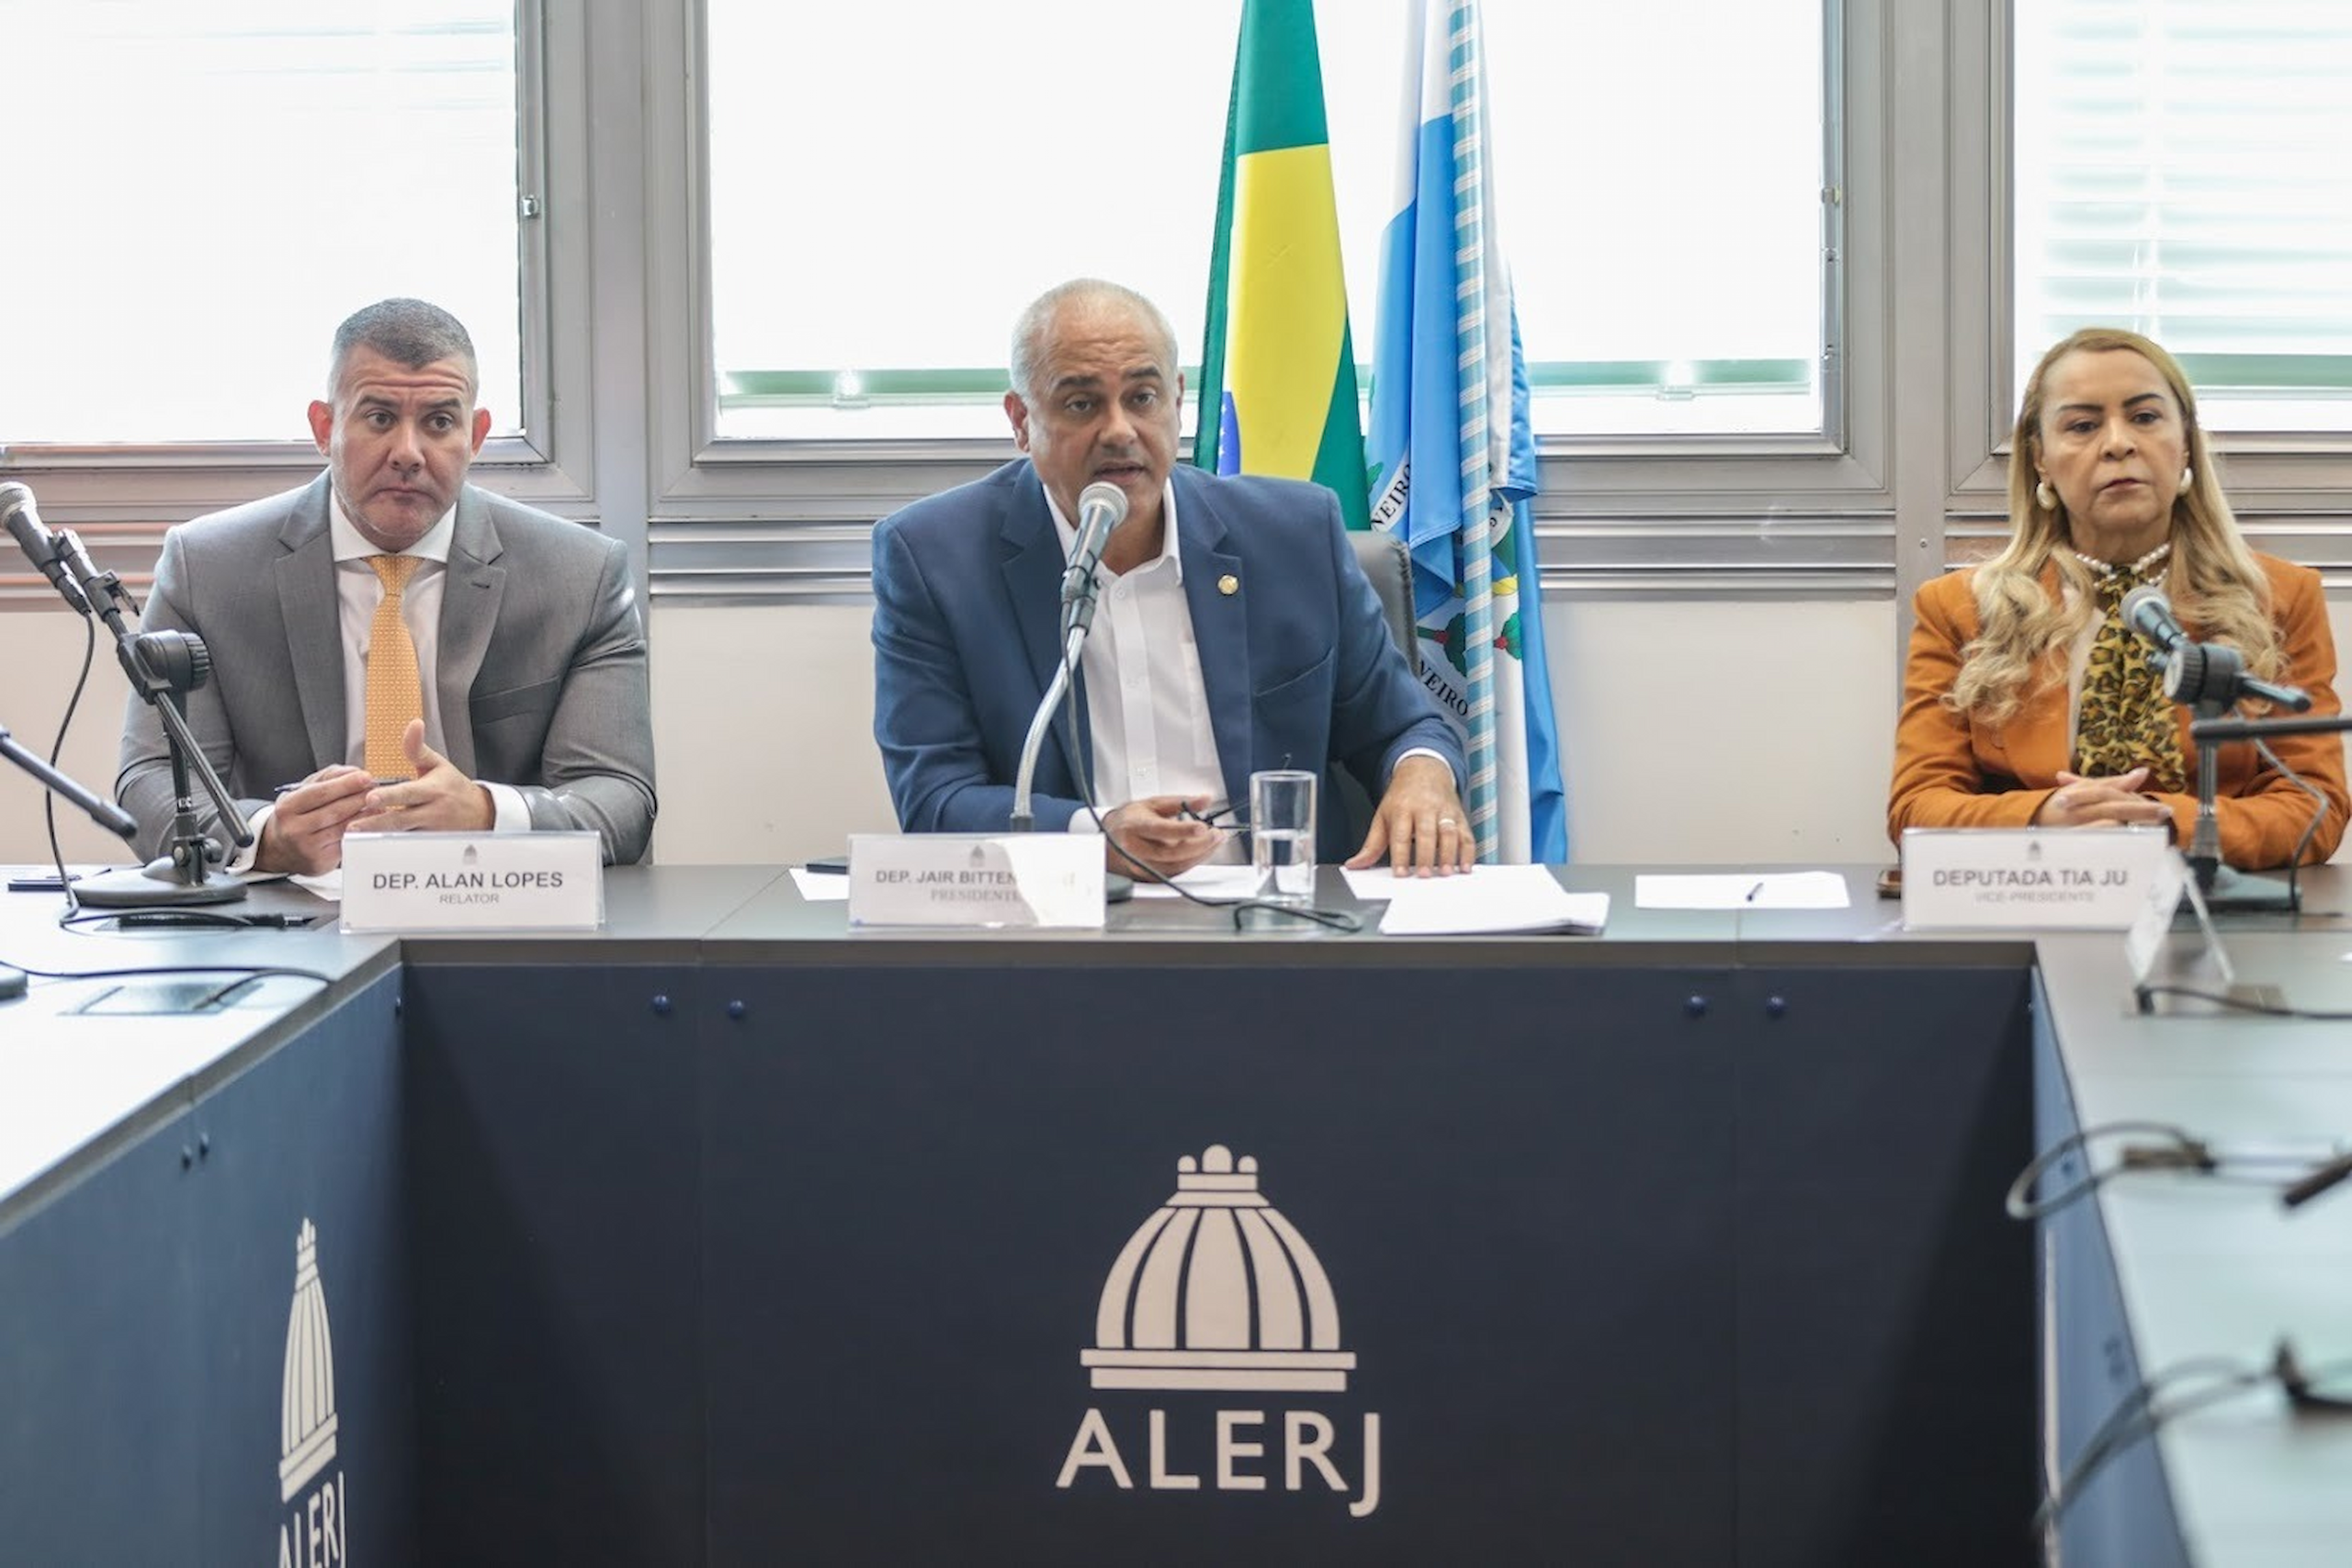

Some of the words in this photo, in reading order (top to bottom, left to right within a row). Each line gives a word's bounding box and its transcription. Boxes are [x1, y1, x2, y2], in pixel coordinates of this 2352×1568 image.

[372, 874, 419, 889] DEP.
[425, 873, 484, 888] ALAN
[492, 872, 563, 887] LOPES
[876, 870, 911, 884] DEP.
[918, 870, 955, 884] JAIR
[1933, 870, 2054, 886] DEPUTADA
[2062, 870, 2095, 886] TIA
[2099, 870, 2128, 886] JU
[439, 894, 500, 905] RELATOR
[931, 889, 1023, 902] PRESIDENTE
[1056, 1407, 1381, 1517] ALERJ
